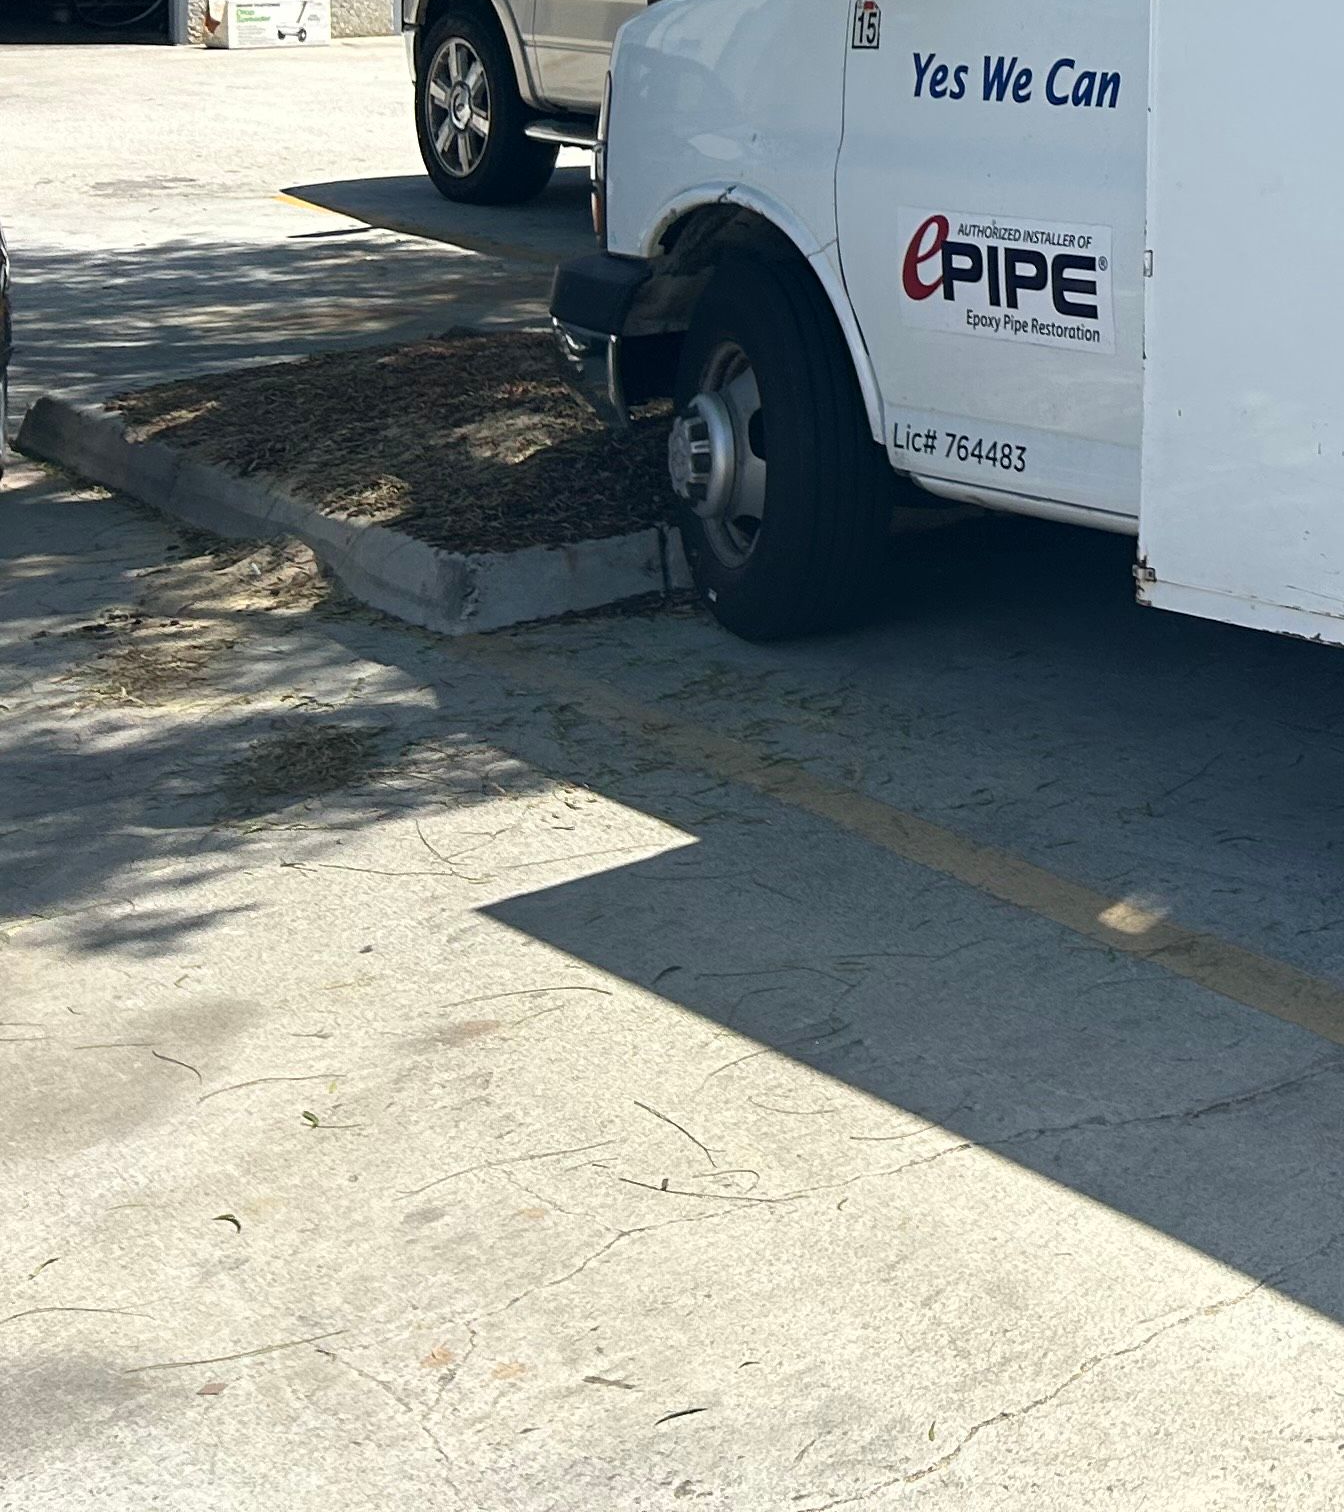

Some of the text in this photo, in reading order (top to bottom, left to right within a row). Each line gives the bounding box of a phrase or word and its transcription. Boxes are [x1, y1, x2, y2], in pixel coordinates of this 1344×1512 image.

[857, 11, 877, 44] 15
[913, 53, 1120, 108] Yes We Can
[957, 221, 1092, 249] AUTHORIZED INSTALLER OF
[966, 309, 1100, 342] Epoxy Pipe Restoration
[893, 423, 1027, 473] Lic# 764483
